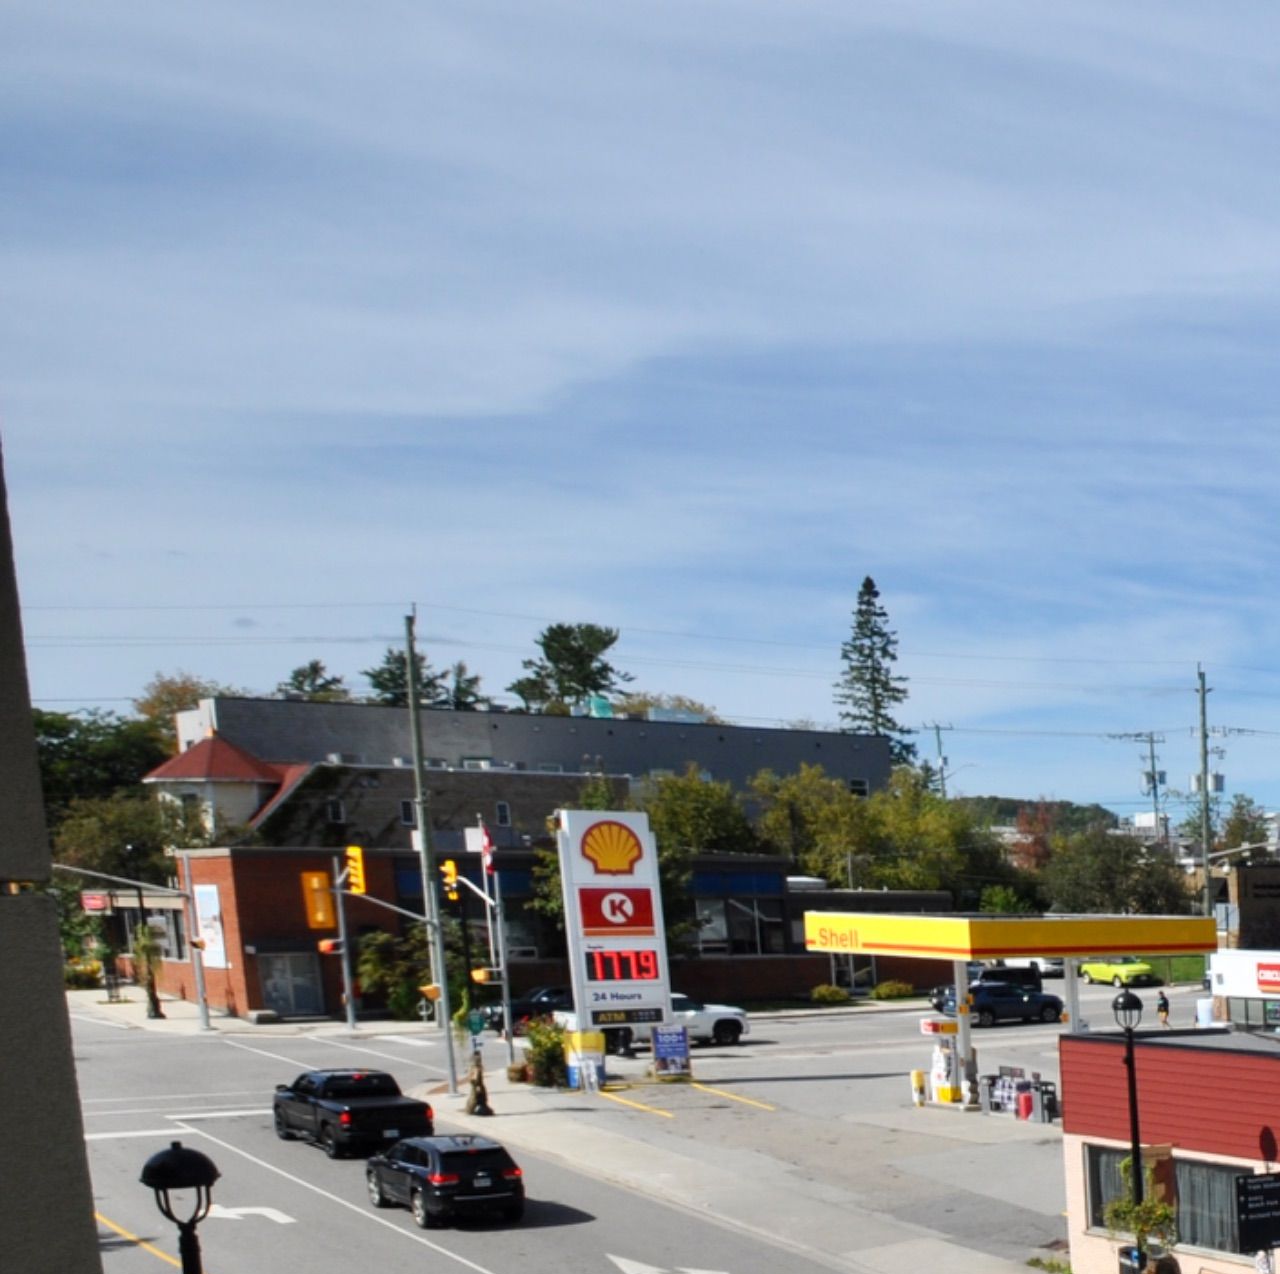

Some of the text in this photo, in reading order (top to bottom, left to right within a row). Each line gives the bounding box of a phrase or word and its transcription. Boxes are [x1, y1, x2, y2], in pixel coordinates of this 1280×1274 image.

[818, 927, 859, 948] Shell
[592, 992, 642, 1001] 24 Hours
[598, 1013, 626, 1022] ATM
